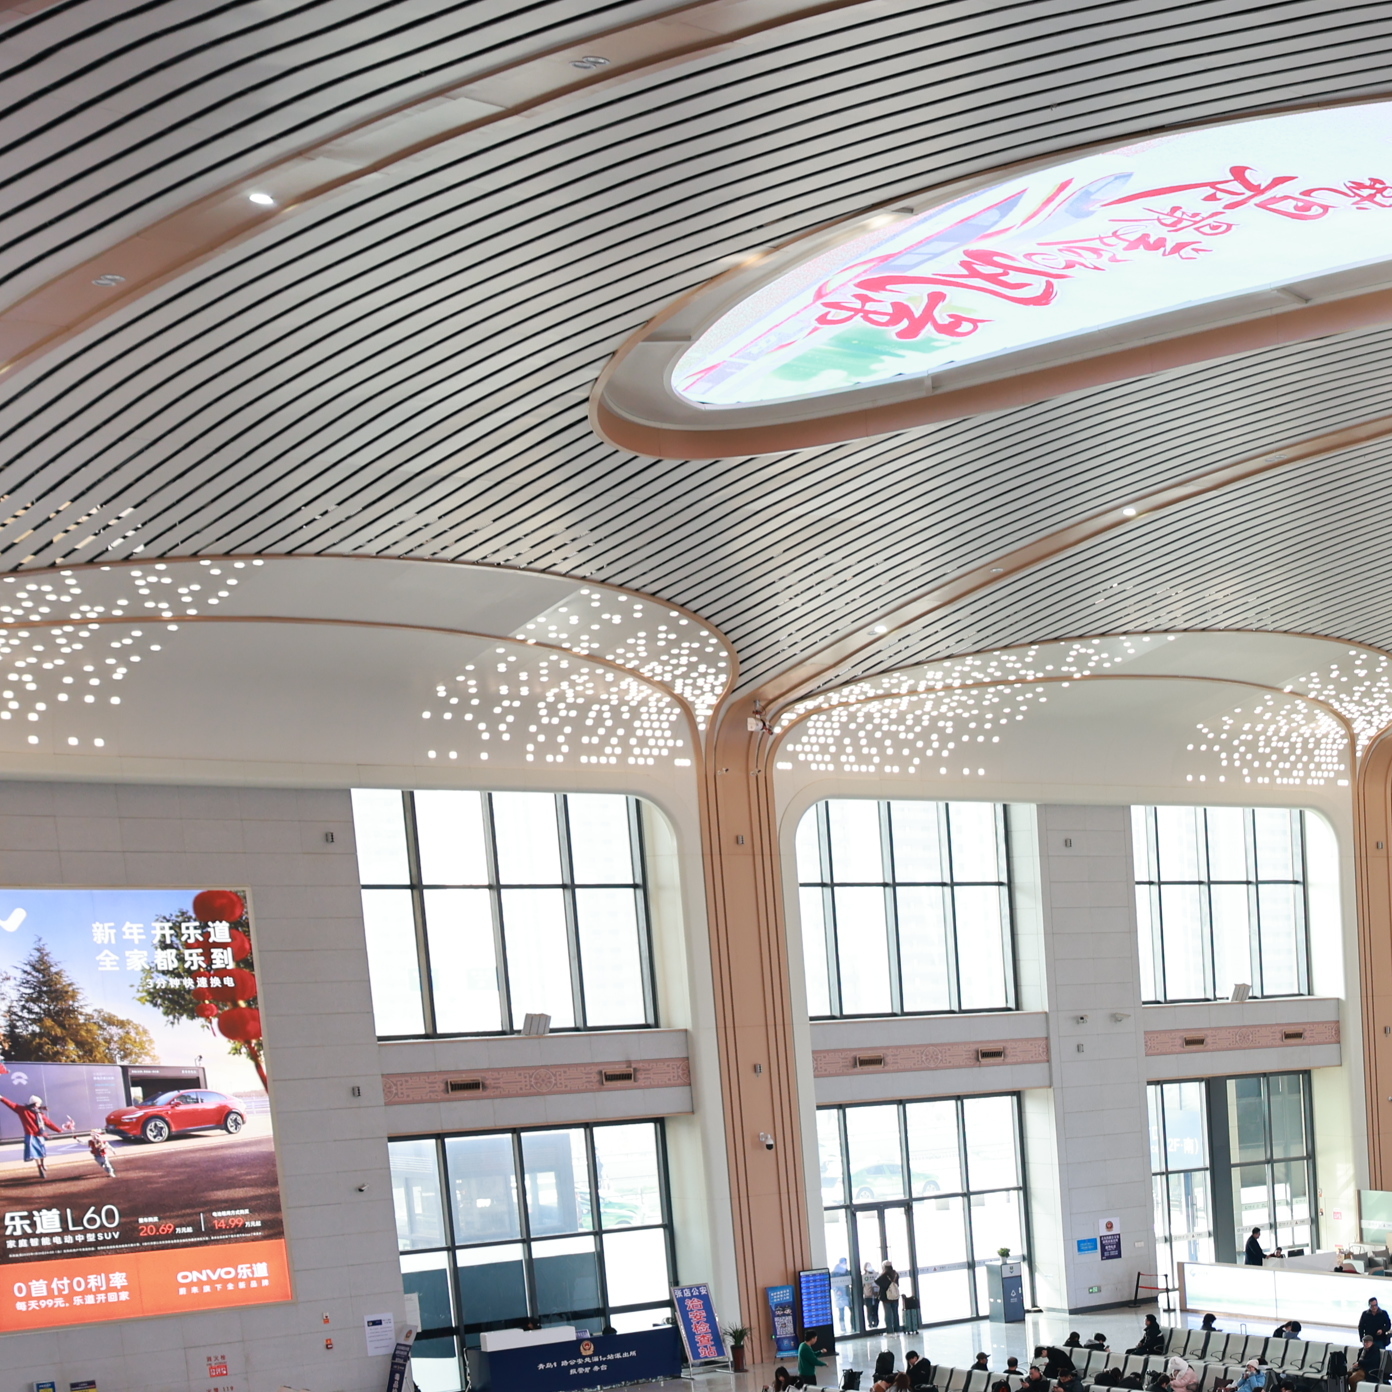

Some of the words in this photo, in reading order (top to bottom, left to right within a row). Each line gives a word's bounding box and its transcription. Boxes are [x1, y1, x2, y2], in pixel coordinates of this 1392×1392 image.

[91, 920, 232, 945] 新年开乐道
[95, 947, 235, 972] 全家都乐到
[146, 976, 236, 989] 3分钟快速换电
[4, 1208, 62, 1236] 乐道
[66, 1204, 120, 1231] L60
[138, 1223, 175, 1237] 20.69
[213, 1217, 245, 1230] 14.99
[6, 1231, 120, 1249] 家庭智能电动中型SUV
[176, 1266, 236, 1284] ONVO
[237, 1262, 269, 1279] 乐道
[13, 1271, 129, 1298] 0首付0利率
[674, 1285, 708, 1298] 张店公安
[684, 1297, 718, 1358] 治安检查站
